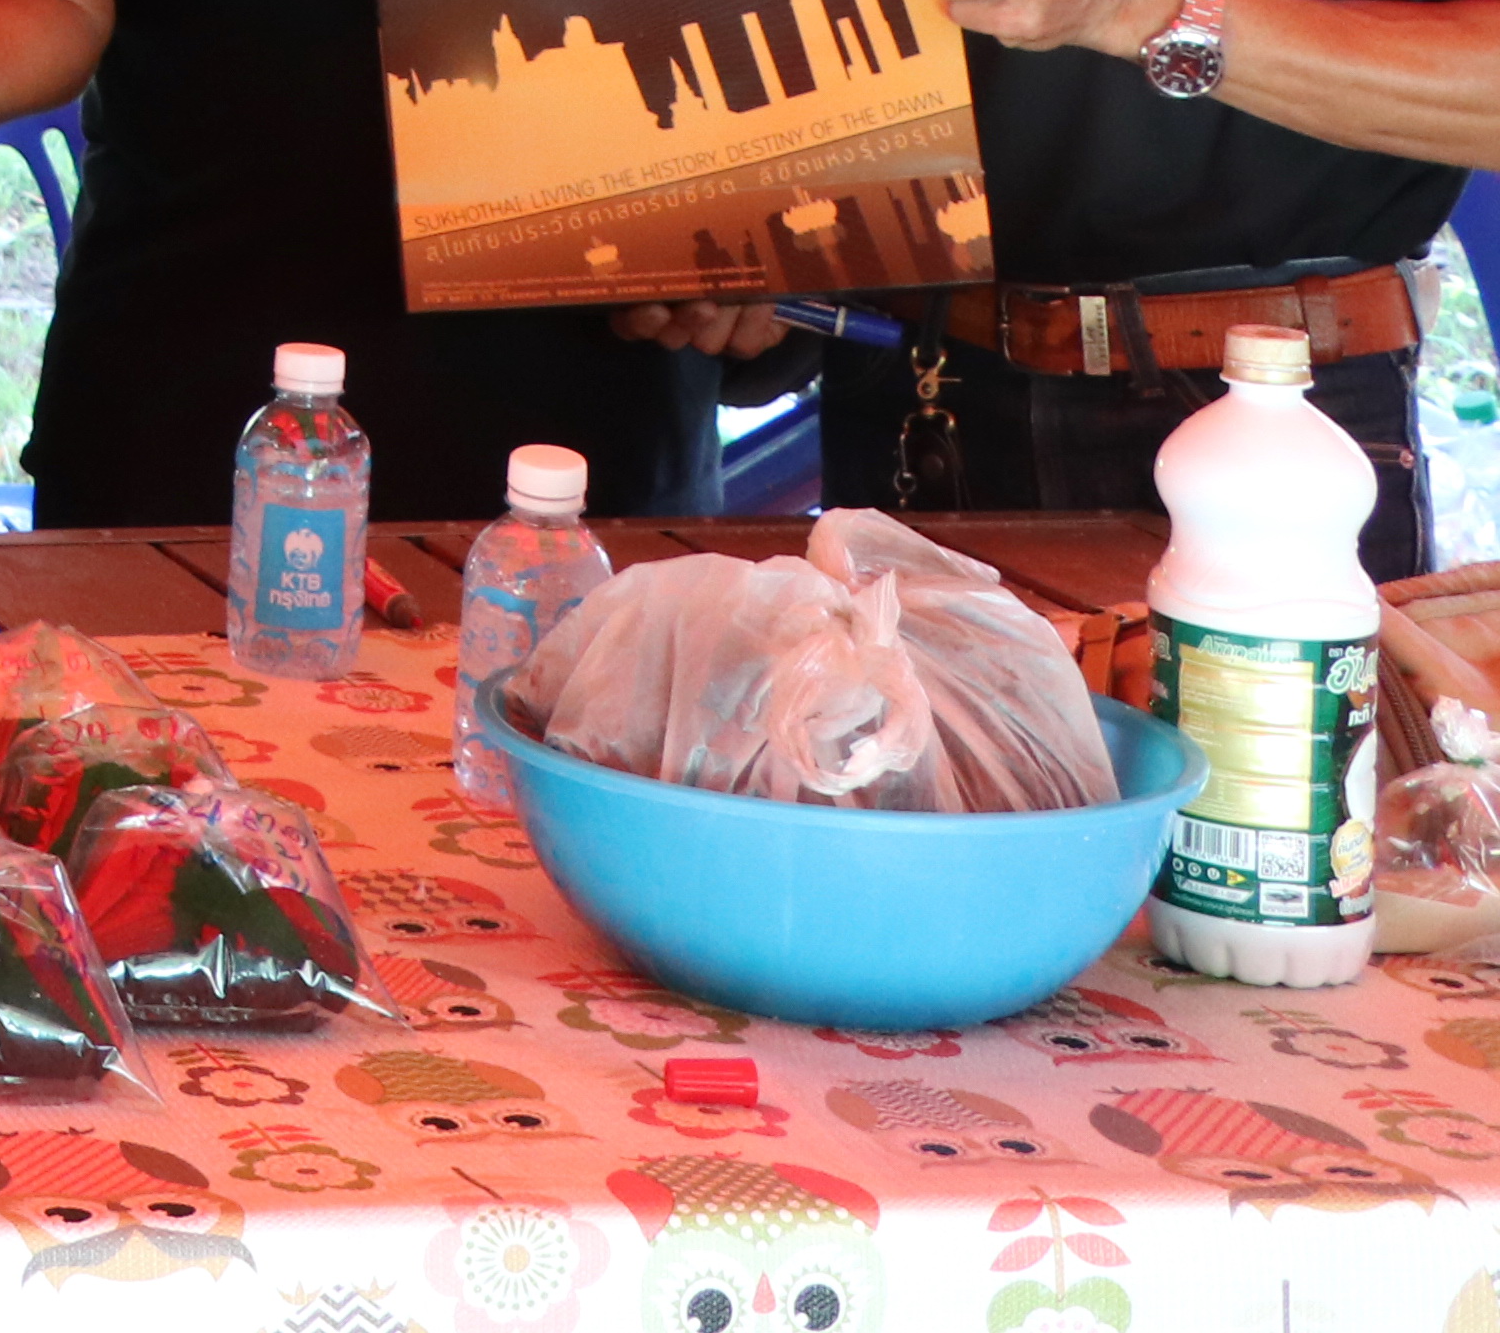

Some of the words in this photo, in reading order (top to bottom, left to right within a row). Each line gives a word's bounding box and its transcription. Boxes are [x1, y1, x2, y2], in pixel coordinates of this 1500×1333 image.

[530, 179, 595, 210] LIVING
[600, 168, 635, 193] THE
[726, 129, 804, 163] DESTINY
[809, 121, 834, 140] OF
[841, 109, 876, 131] THE
[883, 90, 945, 120] DAWN
[280, 572, 322, 591] KTB
